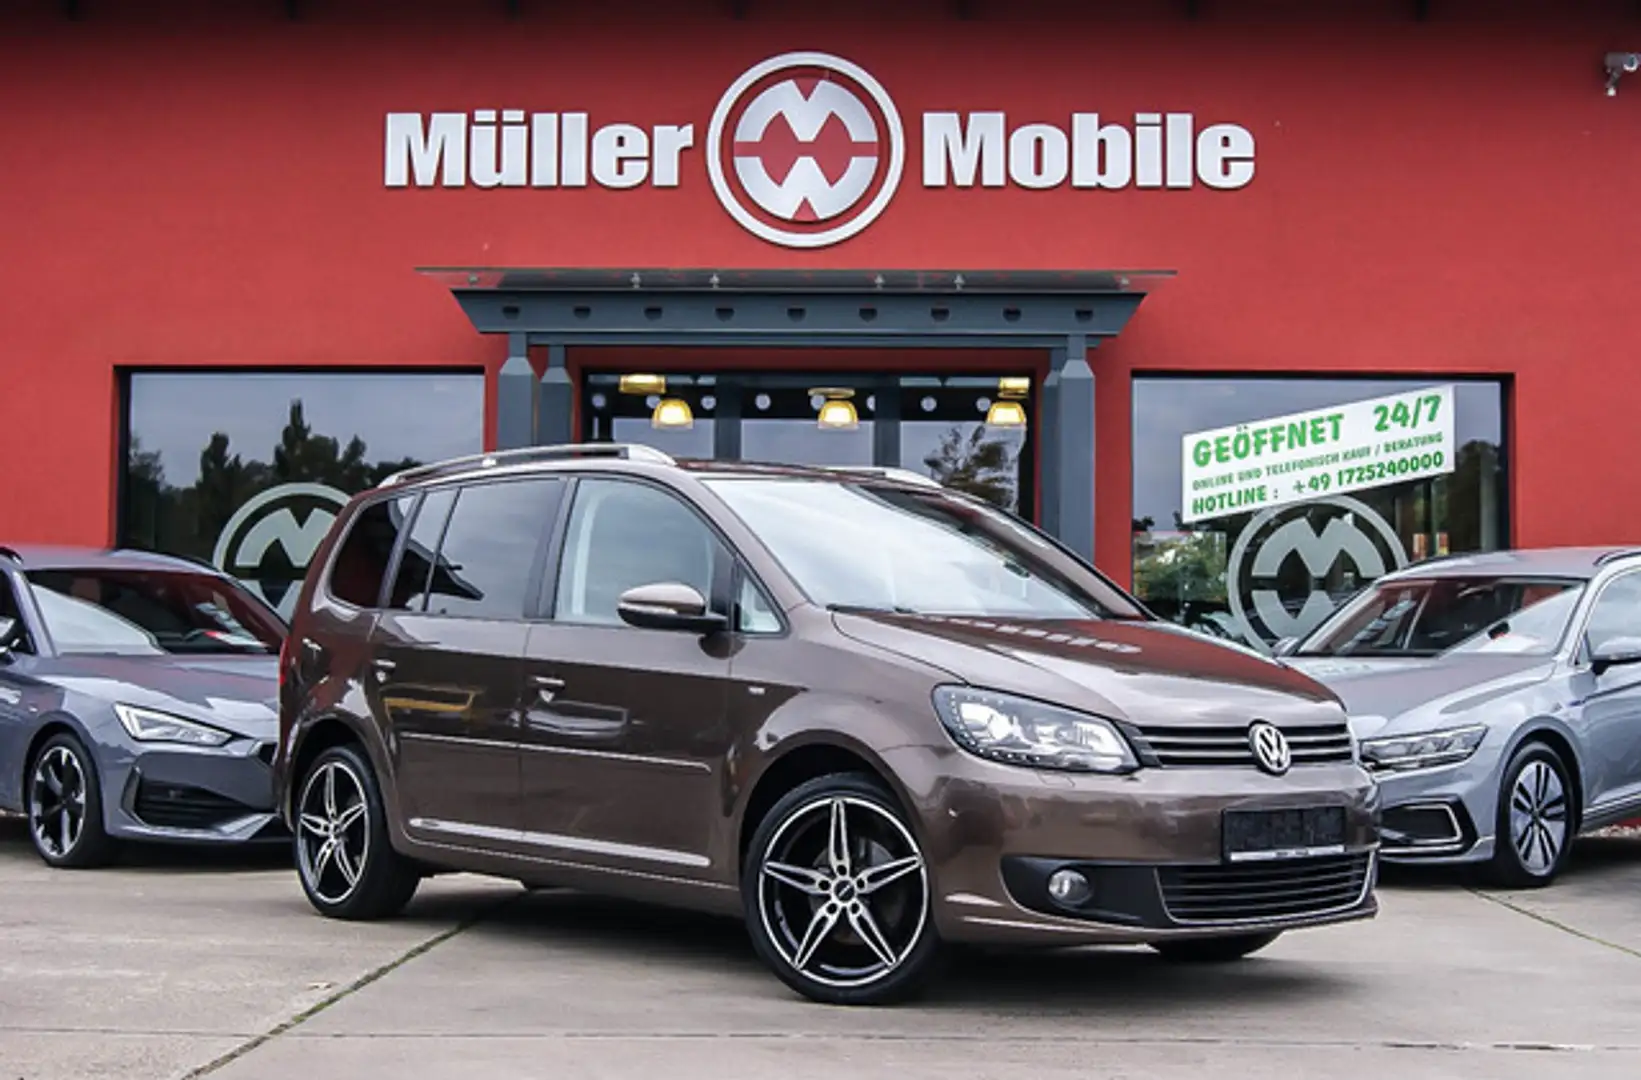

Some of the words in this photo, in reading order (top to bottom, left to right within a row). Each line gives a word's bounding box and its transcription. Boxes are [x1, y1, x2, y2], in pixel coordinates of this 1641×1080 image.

[384, 109, 694, 189] Müller
[922, 111, 1255, 190] Mobile
[1193, 413, 1344, 467] GEÖFFNET
[1373, 395, 1442, 432] 24/7
[1193, 472, 1234, 491] ONLINE
[1238, 467, 1262, 481] UND
[1266, 453, 1340, 476] TELEFONISCH
[1343, 446, 1371, 461] KAUF
[1384, 432, 1443, 453] BERATUNG
[1192, 484, 1267, 515] HOTLINE
[1293, 473, 1332, 494] +49
[1337, 451, 1444, 486] 1725240000
